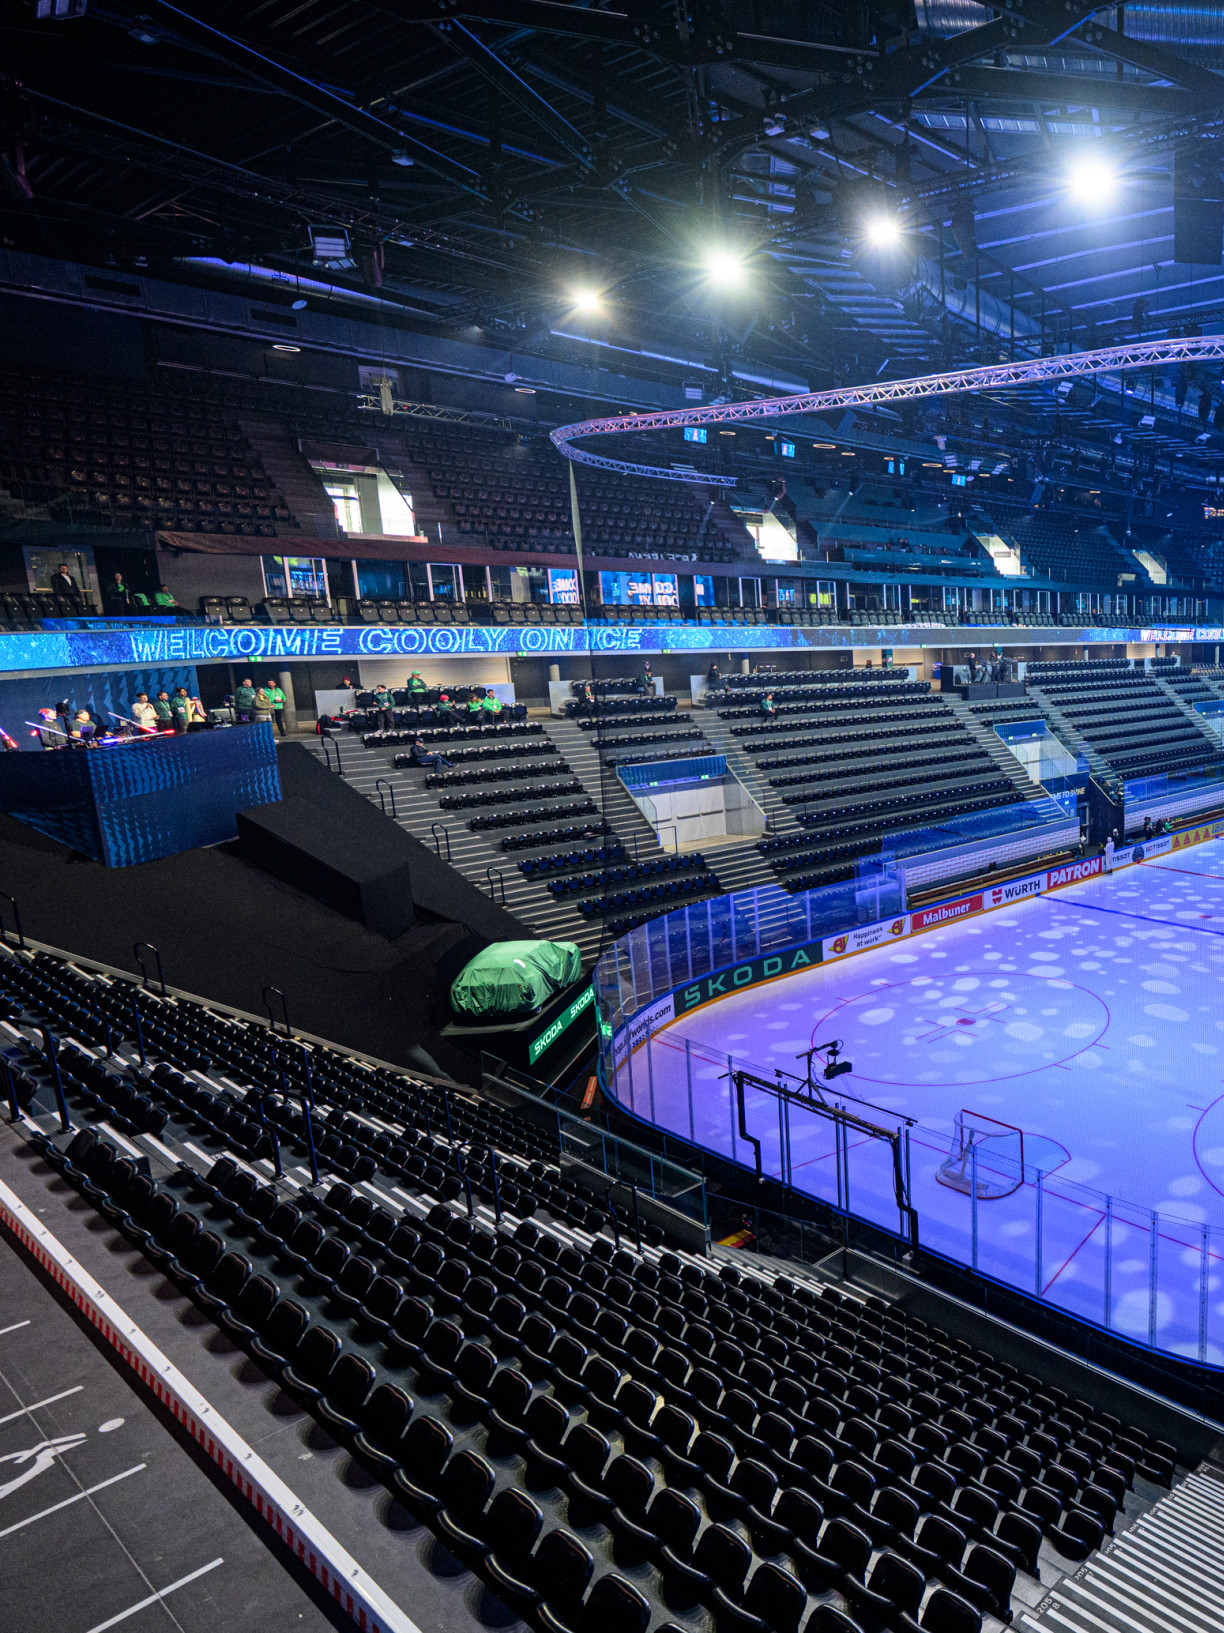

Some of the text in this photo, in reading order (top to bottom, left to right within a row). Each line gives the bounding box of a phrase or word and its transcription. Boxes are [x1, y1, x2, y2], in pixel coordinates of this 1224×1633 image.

[131, 628, 343, 662] WELCOME
[359, 627, 509, 653] COOLY
[520, 627, 574, 652] ON
[1153, 840, 1170, 850] TISSOT
[1112, 852, 1130, 862] TISSOT
[1050, 859, 1100, 887] PATRON
[1005, 879, 1041, 899] WÜRTH
[923, 901, 971, 926] Malbuner
[853, 926, 883, 940] Happiness
[684, 950, 811, 1008] SKODA
[534, 988, 594, 1056] SKODA SKODA
[1036, 1597, 1053, 1614] 205
[1052, 1602, 1060, 1610] 8
